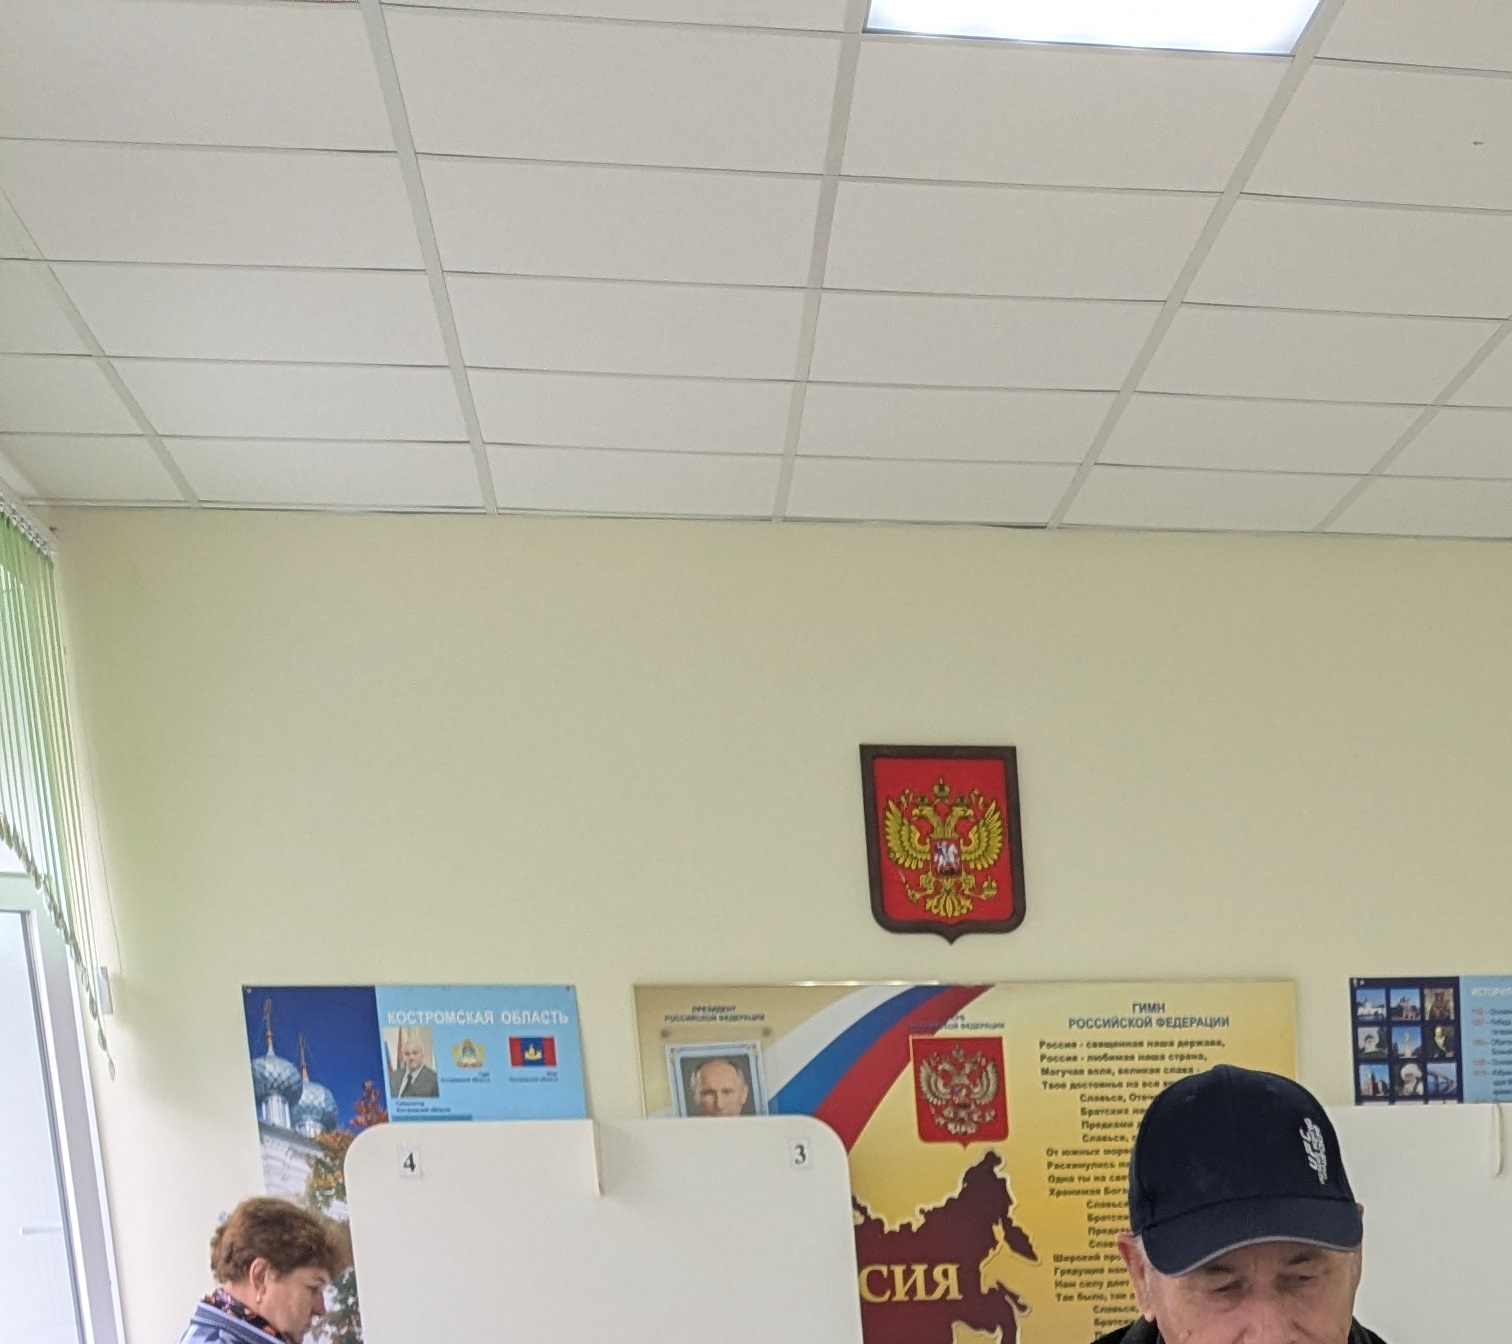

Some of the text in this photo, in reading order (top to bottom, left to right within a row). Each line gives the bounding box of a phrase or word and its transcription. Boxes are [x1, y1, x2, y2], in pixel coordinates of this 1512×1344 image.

[1131, 1002, 1166, 1014] ГИМН
[387, 1009, 570, 1025] КОСТРОМСКАЯ ОБЛАСТЬ
[1068, 1015, 1230, 1029] РОССИЙСКОЙ ФЕДЕРАЦИИ
[1039, 1040, 1078, 1050] Россия
[1040, 1053, 1078, 1063] Россия
[403, 1151, 416, 1172] 4
[794, 1144, 807, 1165] 3
[859, 1262, 964, 1303] СИЯ
